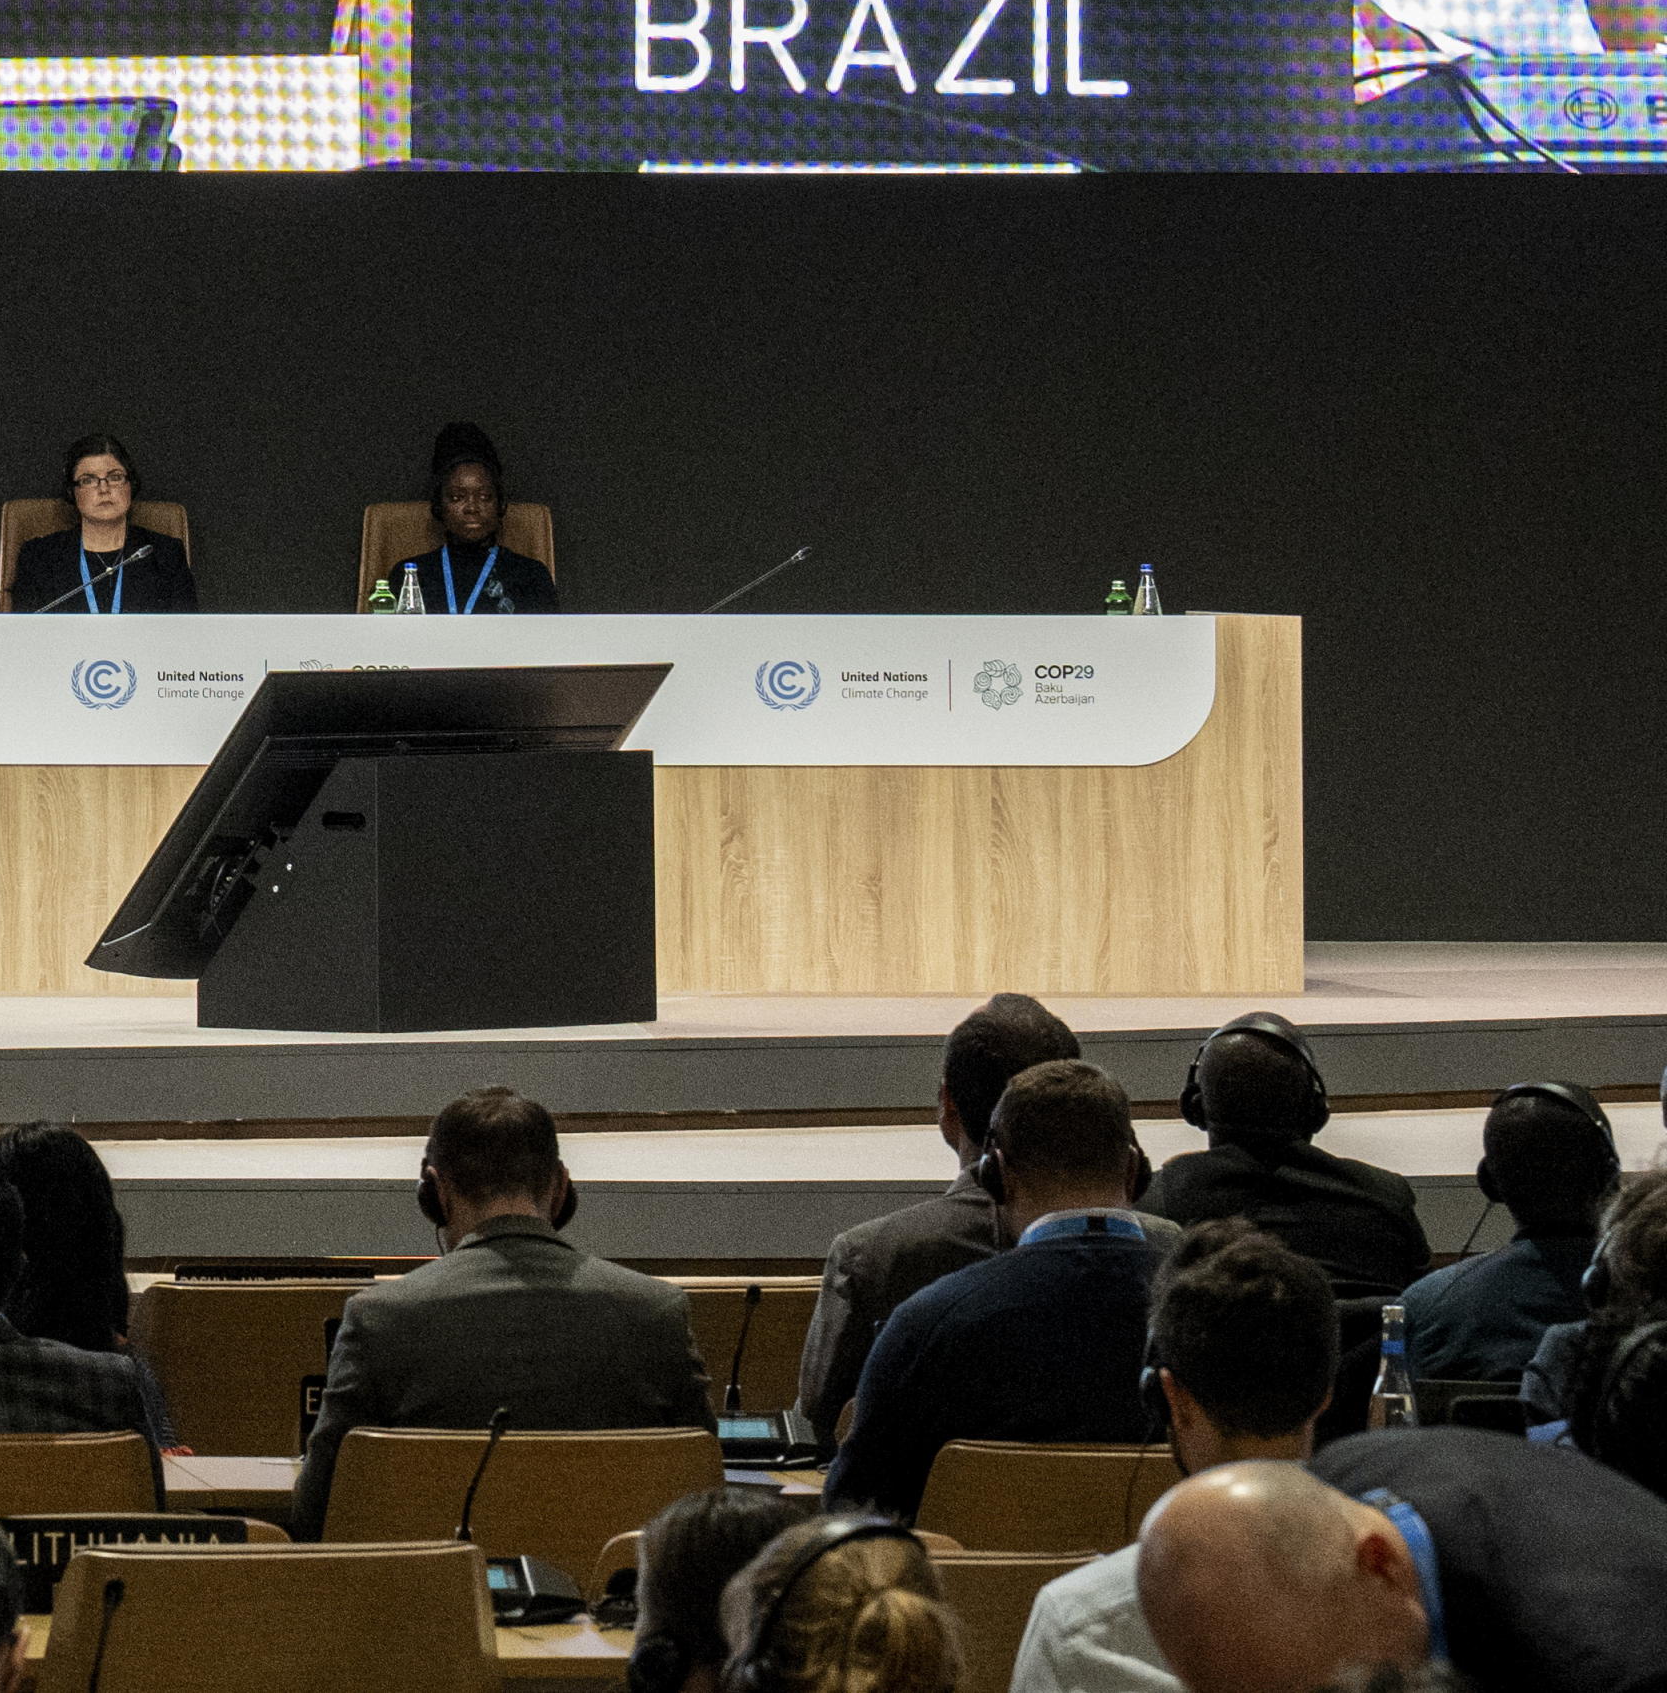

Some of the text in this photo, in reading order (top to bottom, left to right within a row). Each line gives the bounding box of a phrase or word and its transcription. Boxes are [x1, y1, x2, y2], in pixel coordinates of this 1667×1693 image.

[157, 671, 244, 682] United Nations
[841, 671, 928, 682] United Nations
[1034, 665, 1094, 679] COP29
[157, 687, 244, 702] Climate Change
[1034, 683, 1063, 693] Baku
[841, 688, 929, 702] Climate Change
[1034, 693, 1095, 706] Azerbaijan
